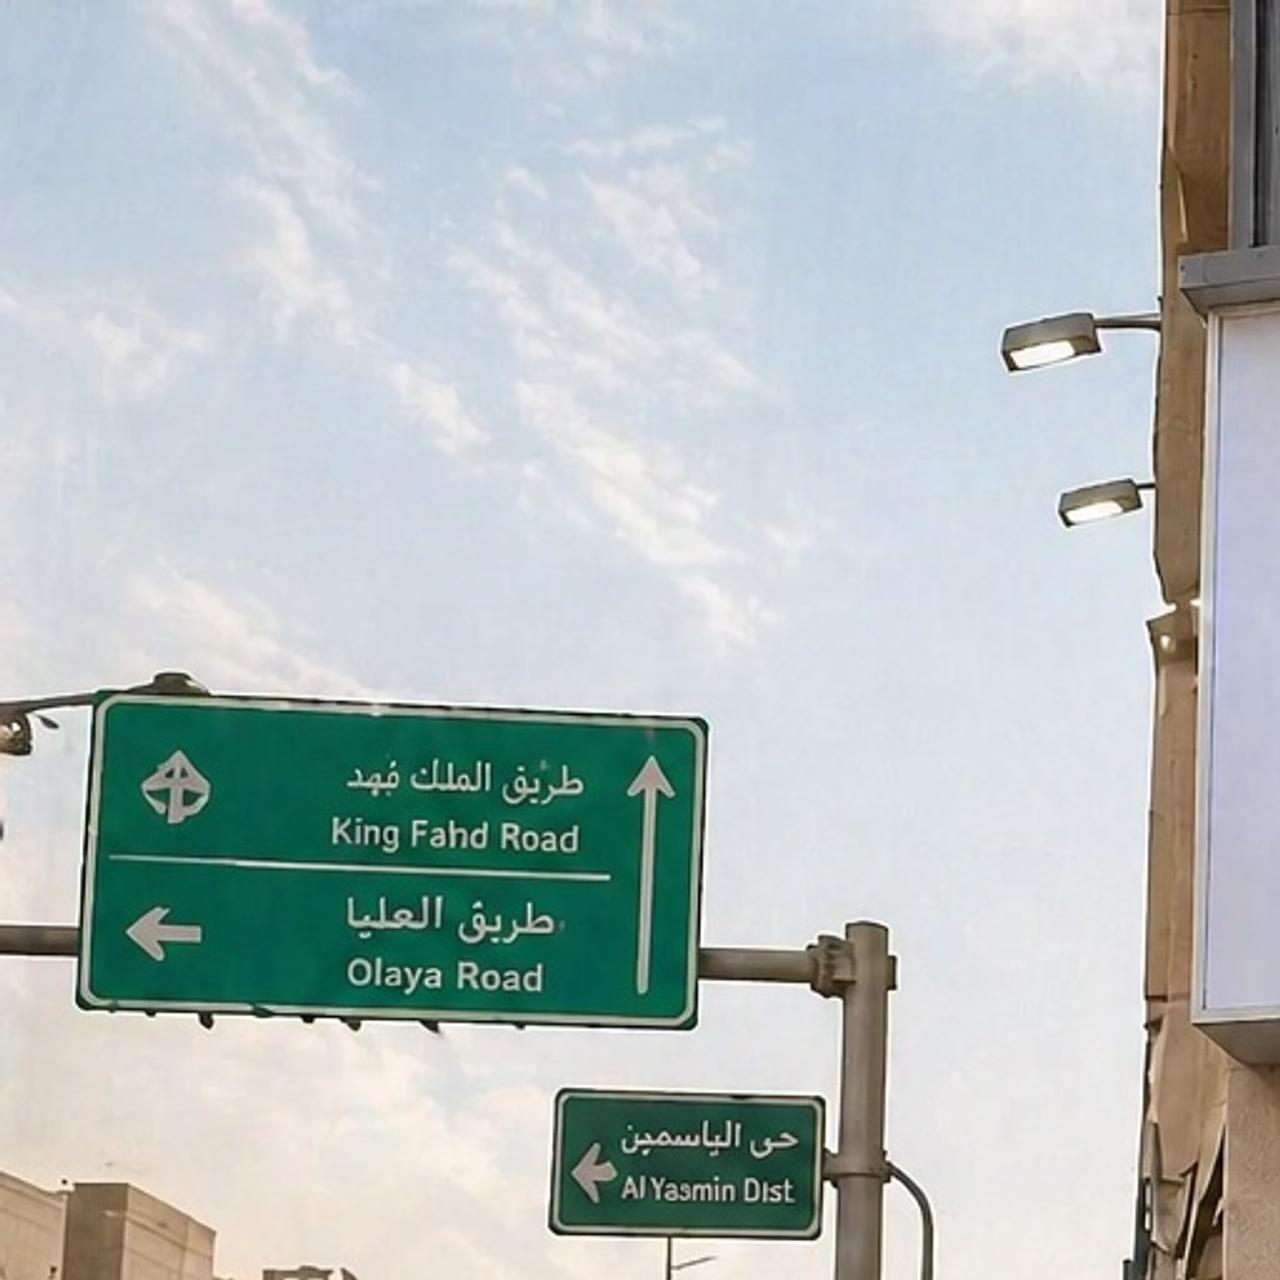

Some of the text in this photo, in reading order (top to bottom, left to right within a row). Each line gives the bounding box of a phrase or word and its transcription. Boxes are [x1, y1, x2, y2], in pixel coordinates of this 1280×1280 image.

[410, 758, 491, 792] الملك
[502, 761, 584, 805] طريق
[332, 816, 579, 854] King Fahd Road
[347, 895, 554, 944] طريق العليا
[347, 957, 543, 995] Olaya Road
[621, 1175, 794, 1203] Al Yasmin Dist
